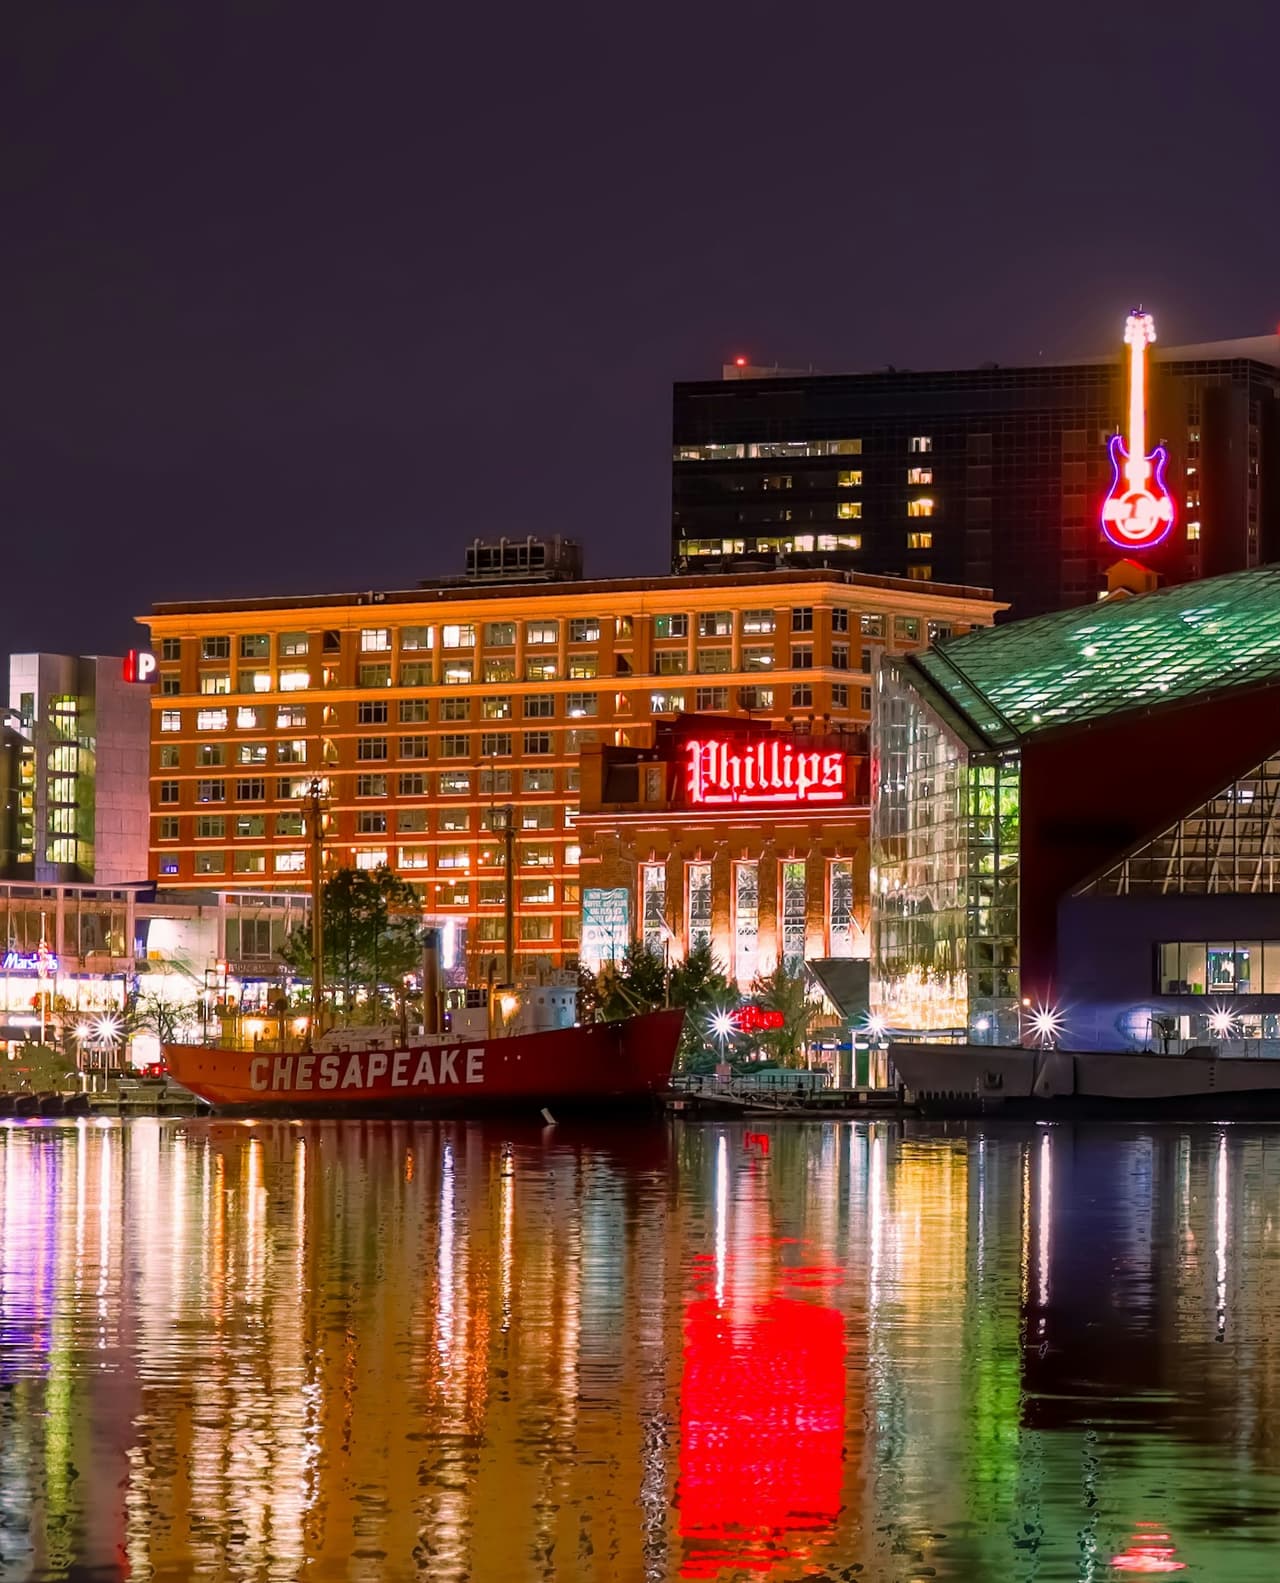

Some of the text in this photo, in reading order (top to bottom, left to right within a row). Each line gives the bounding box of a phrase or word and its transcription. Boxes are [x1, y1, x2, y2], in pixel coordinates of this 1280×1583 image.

[139, 653, 156, 680] P
[686, 740, 842, 803] Phillips
[251, 1049, 485, 1091] CHESAPEAKE
